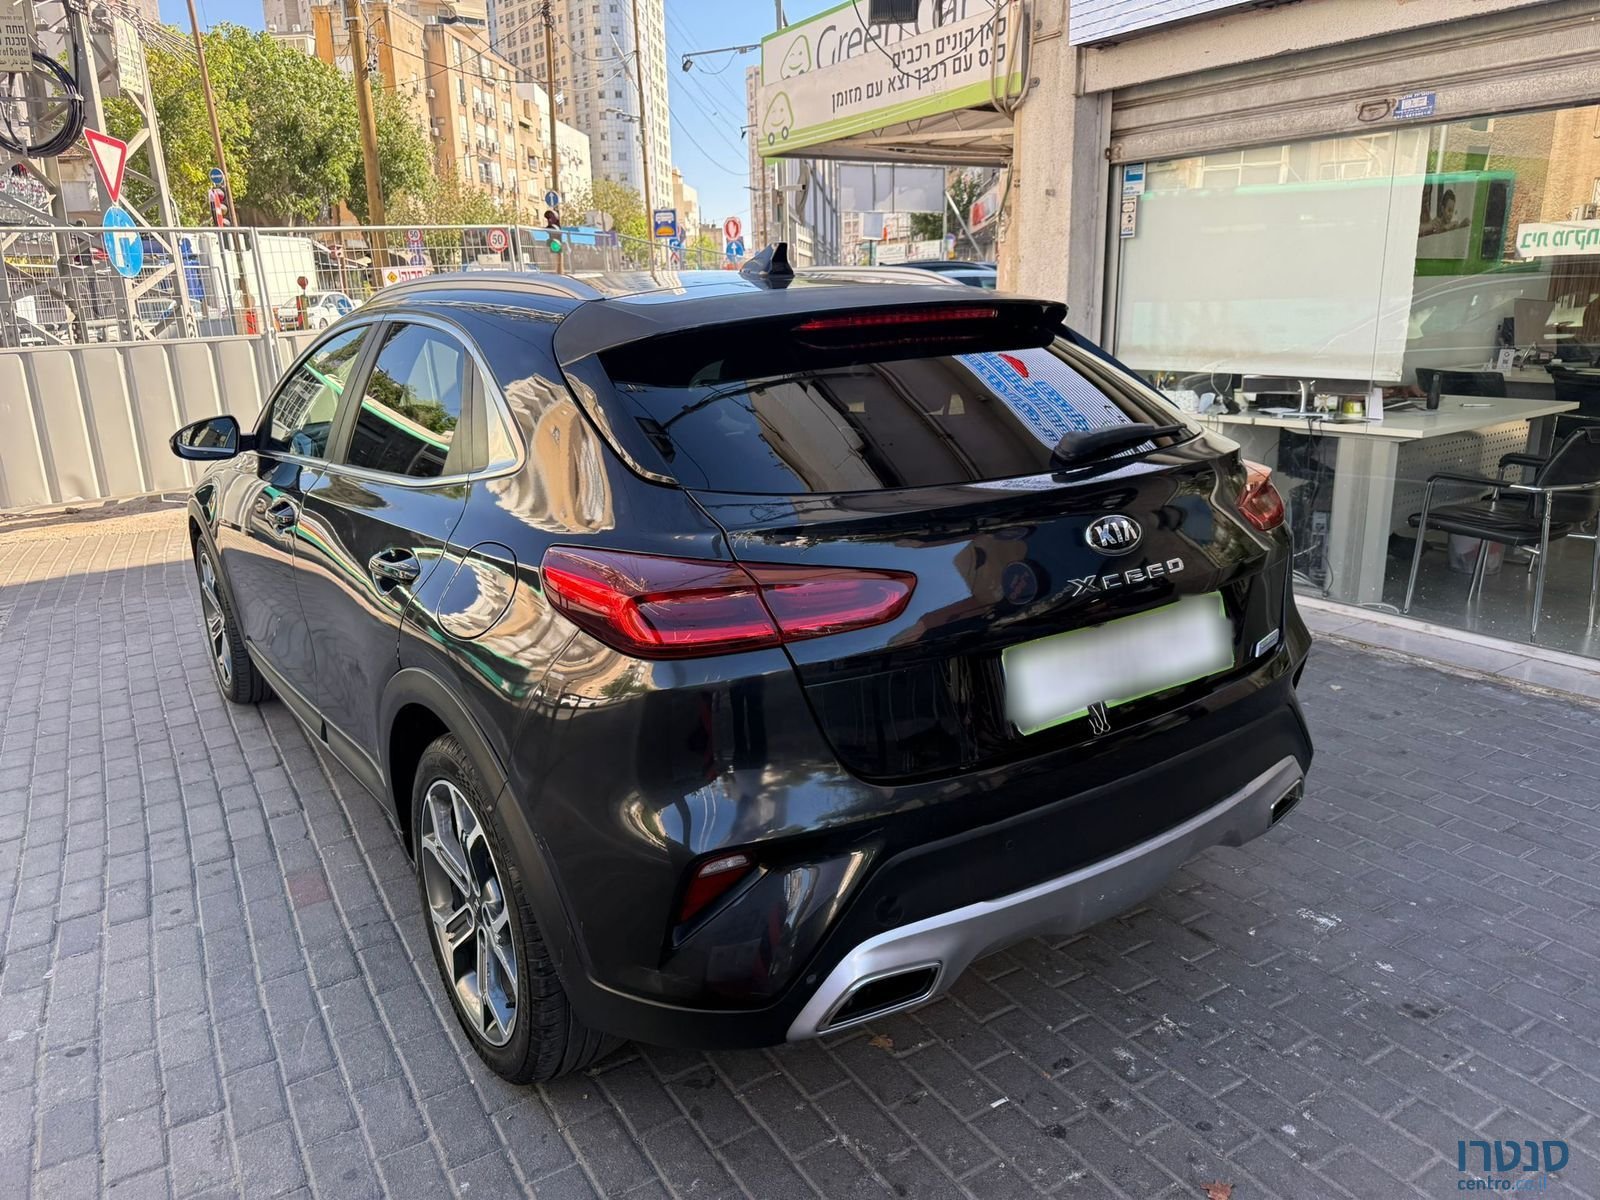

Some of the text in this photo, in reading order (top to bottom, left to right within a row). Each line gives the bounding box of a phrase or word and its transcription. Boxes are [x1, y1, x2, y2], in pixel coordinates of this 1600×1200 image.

[936, 27, 974, 55] קונים
[892, 42, 930, 69] רכבים
[831, 43, 1006, 113] כס עם רכבך וצא עם מזומן
[409, 231, 419, 239] 50
[491, 234, 503, 245] 50
[1094, 519, 1138, 547] KIA
[1066, 557, 1185, 597] XCEED
